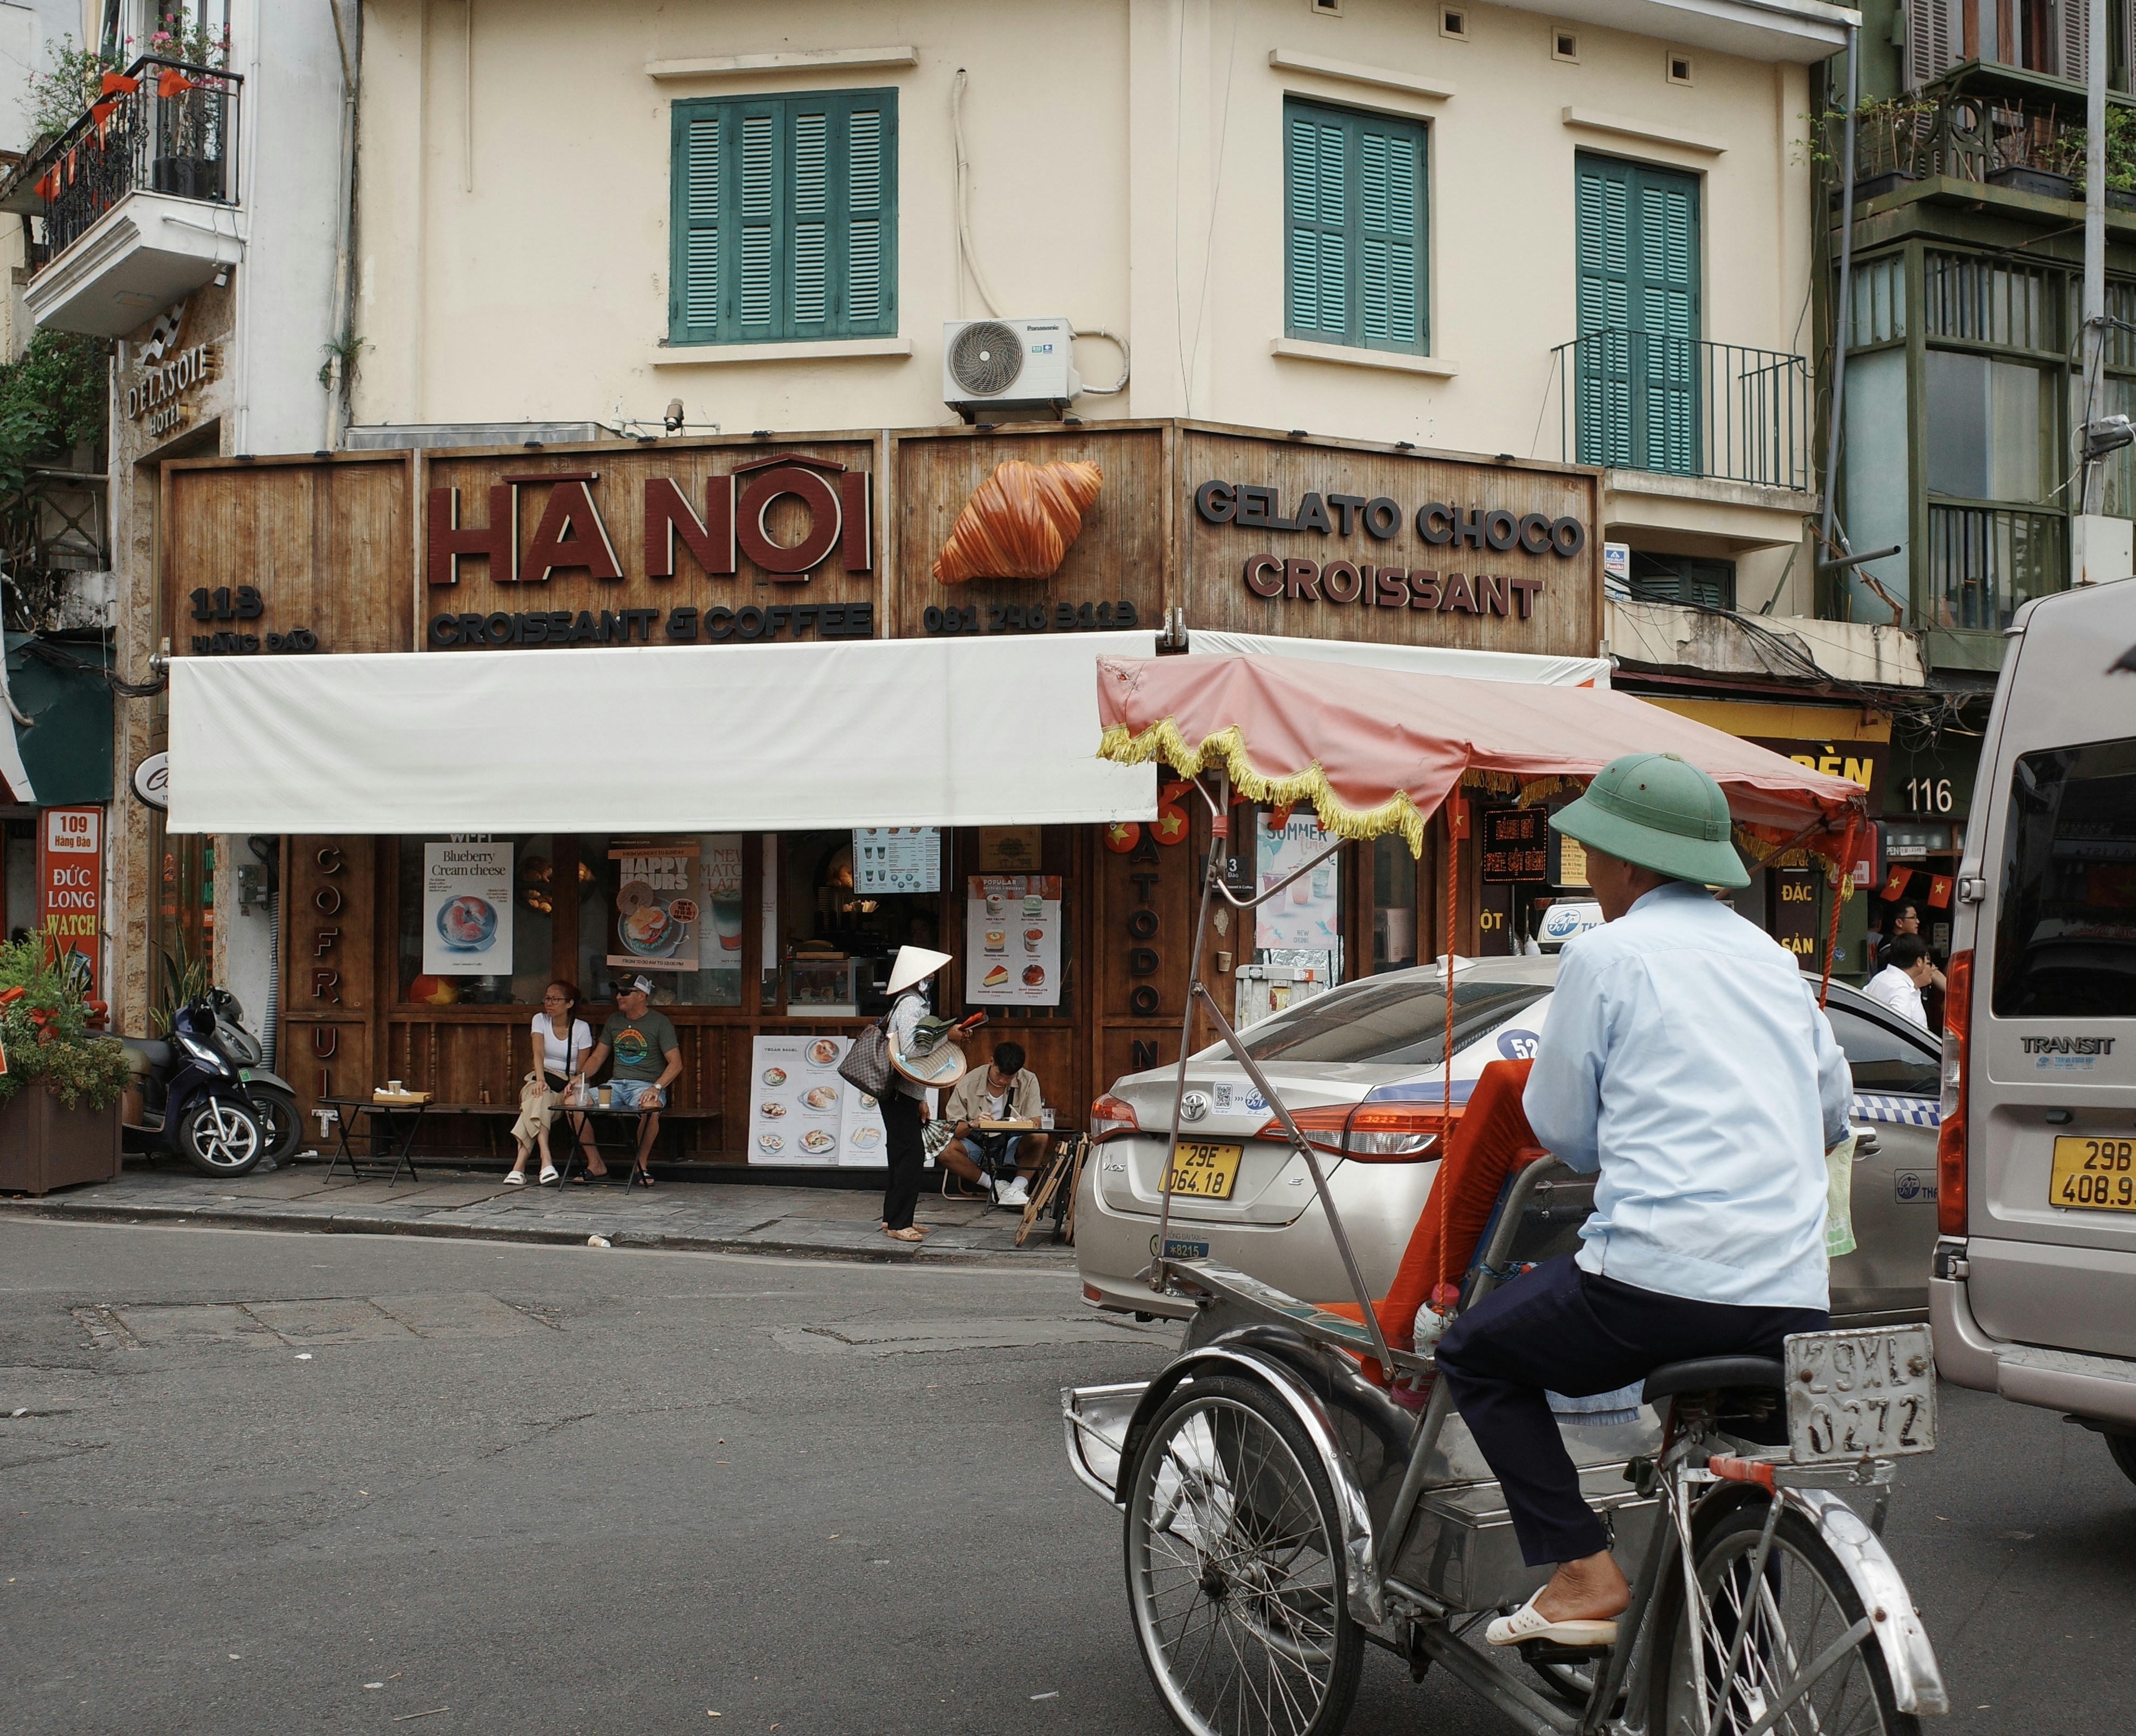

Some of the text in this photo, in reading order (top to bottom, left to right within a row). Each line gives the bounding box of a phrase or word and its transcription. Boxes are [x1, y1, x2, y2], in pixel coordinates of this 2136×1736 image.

[128, 342, 207, 420] DELASOIE
[149, 402, 181, 437] HOTEL
[1195, 479, 1585, 558] GELATO CHOCO
[1243, 553, 1545, 618] CROISSANT
[189, 585, 264, 620] 113
[430, 602, 874, 646] CROISSANT & COFFEE
[923, 600, 1139, 632] 081 246 3113
[1907, 777, 1953, 813] 116
[60, 815, 88, 833] 109
[55, 834, 91, 848] Hàng Đào
[1299, 832, 1327, 855] time
[1886, 847, 1900, 855] PEN
[443, 850, 495, 864] Blueberry
[620, 857, 688, 873] HAPPY
[53, 864, 92, 887] ĐỨC
[432, 864, 506, 876] Cream cheese
[48, 890, 96, 908] LONG
[1781, 882, 1812, 904] ĐẶC
[46, 914, 96, 936] WATCH
[1480, 908, 1504, 933] ỘT
[1781, 932, 1814, 954] SẢN
[2020, 1036, 2116, 1055] TRANSIT
[1103, 1162, 1126, 1172] VIOS
[1185, 1145, 1219, 1168] 29E
[2084, 1141, 2132, 1171] 29B
[1171, 1169, 1225, 1194] 064.18
[2062, 1175, 2136, 1206] 408.9
[1807, 1393, 1919, 1454] 0272
